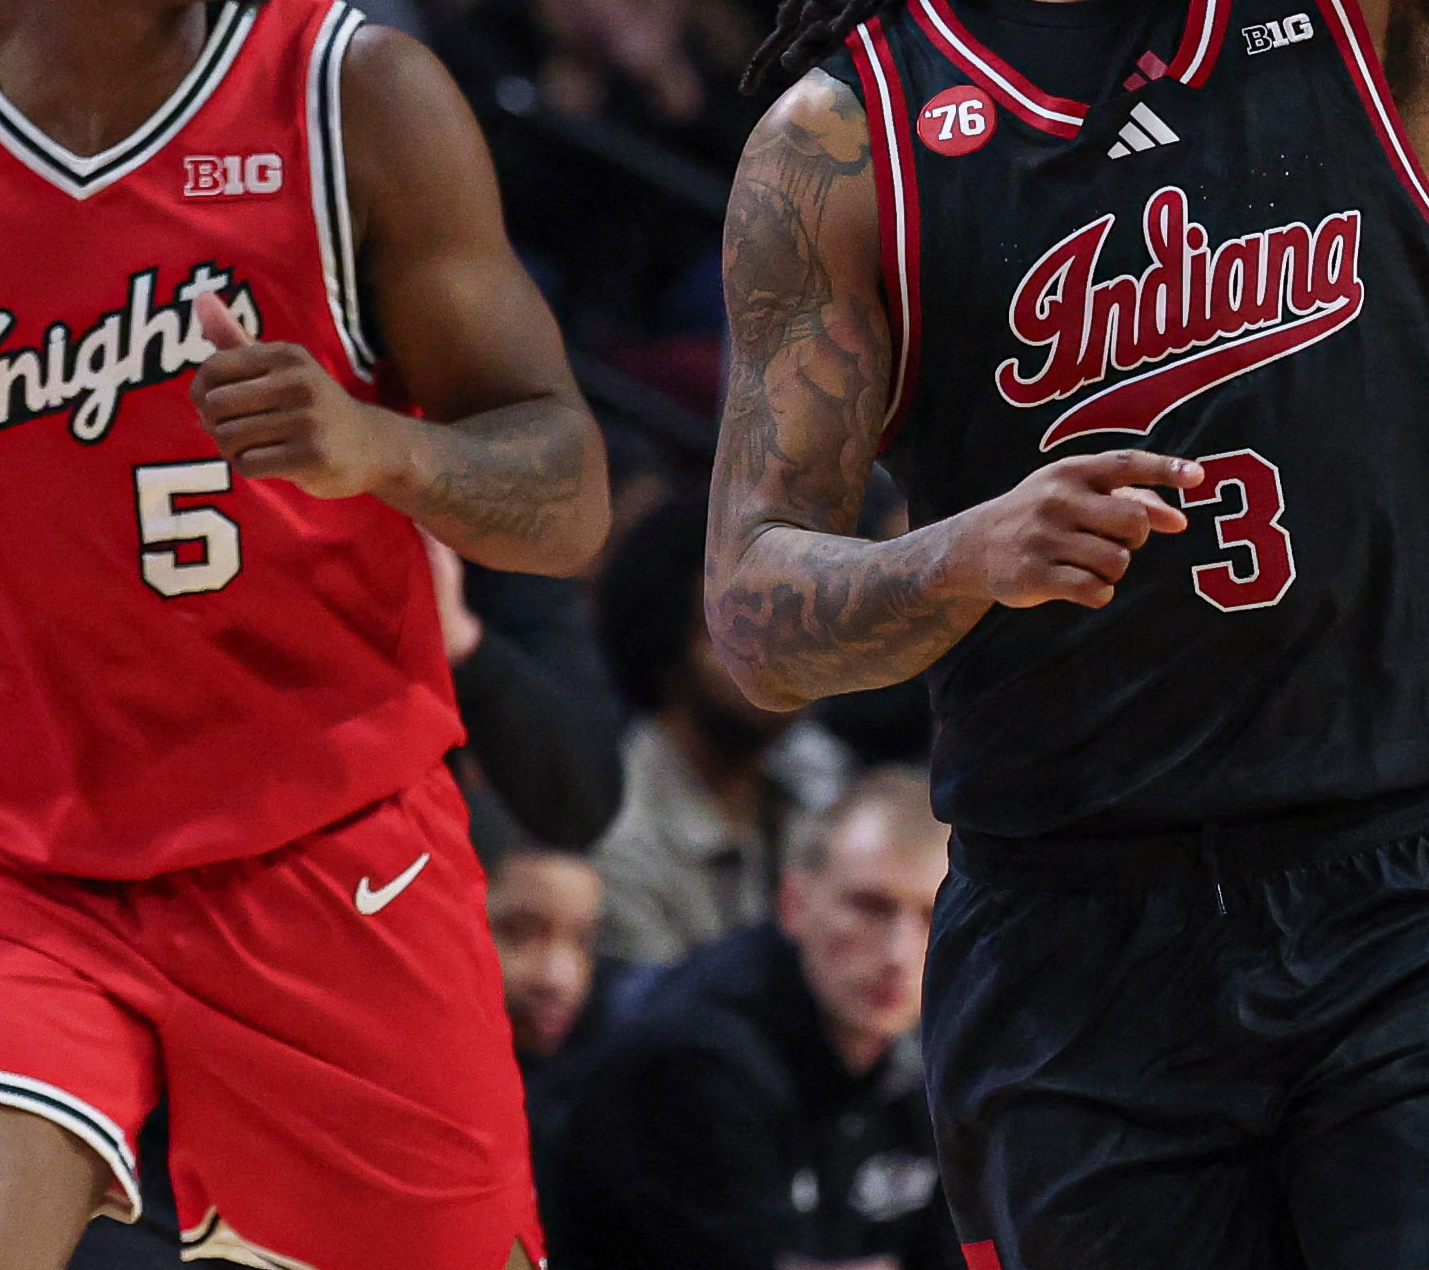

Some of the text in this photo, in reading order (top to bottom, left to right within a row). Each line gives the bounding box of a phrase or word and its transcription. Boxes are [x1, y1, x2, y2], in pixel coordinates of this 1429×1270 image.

[995, 186, 1365, 408] Indiana
[134, 460, 242, 597] 5
[1178, 448, 1298, 613] 3
